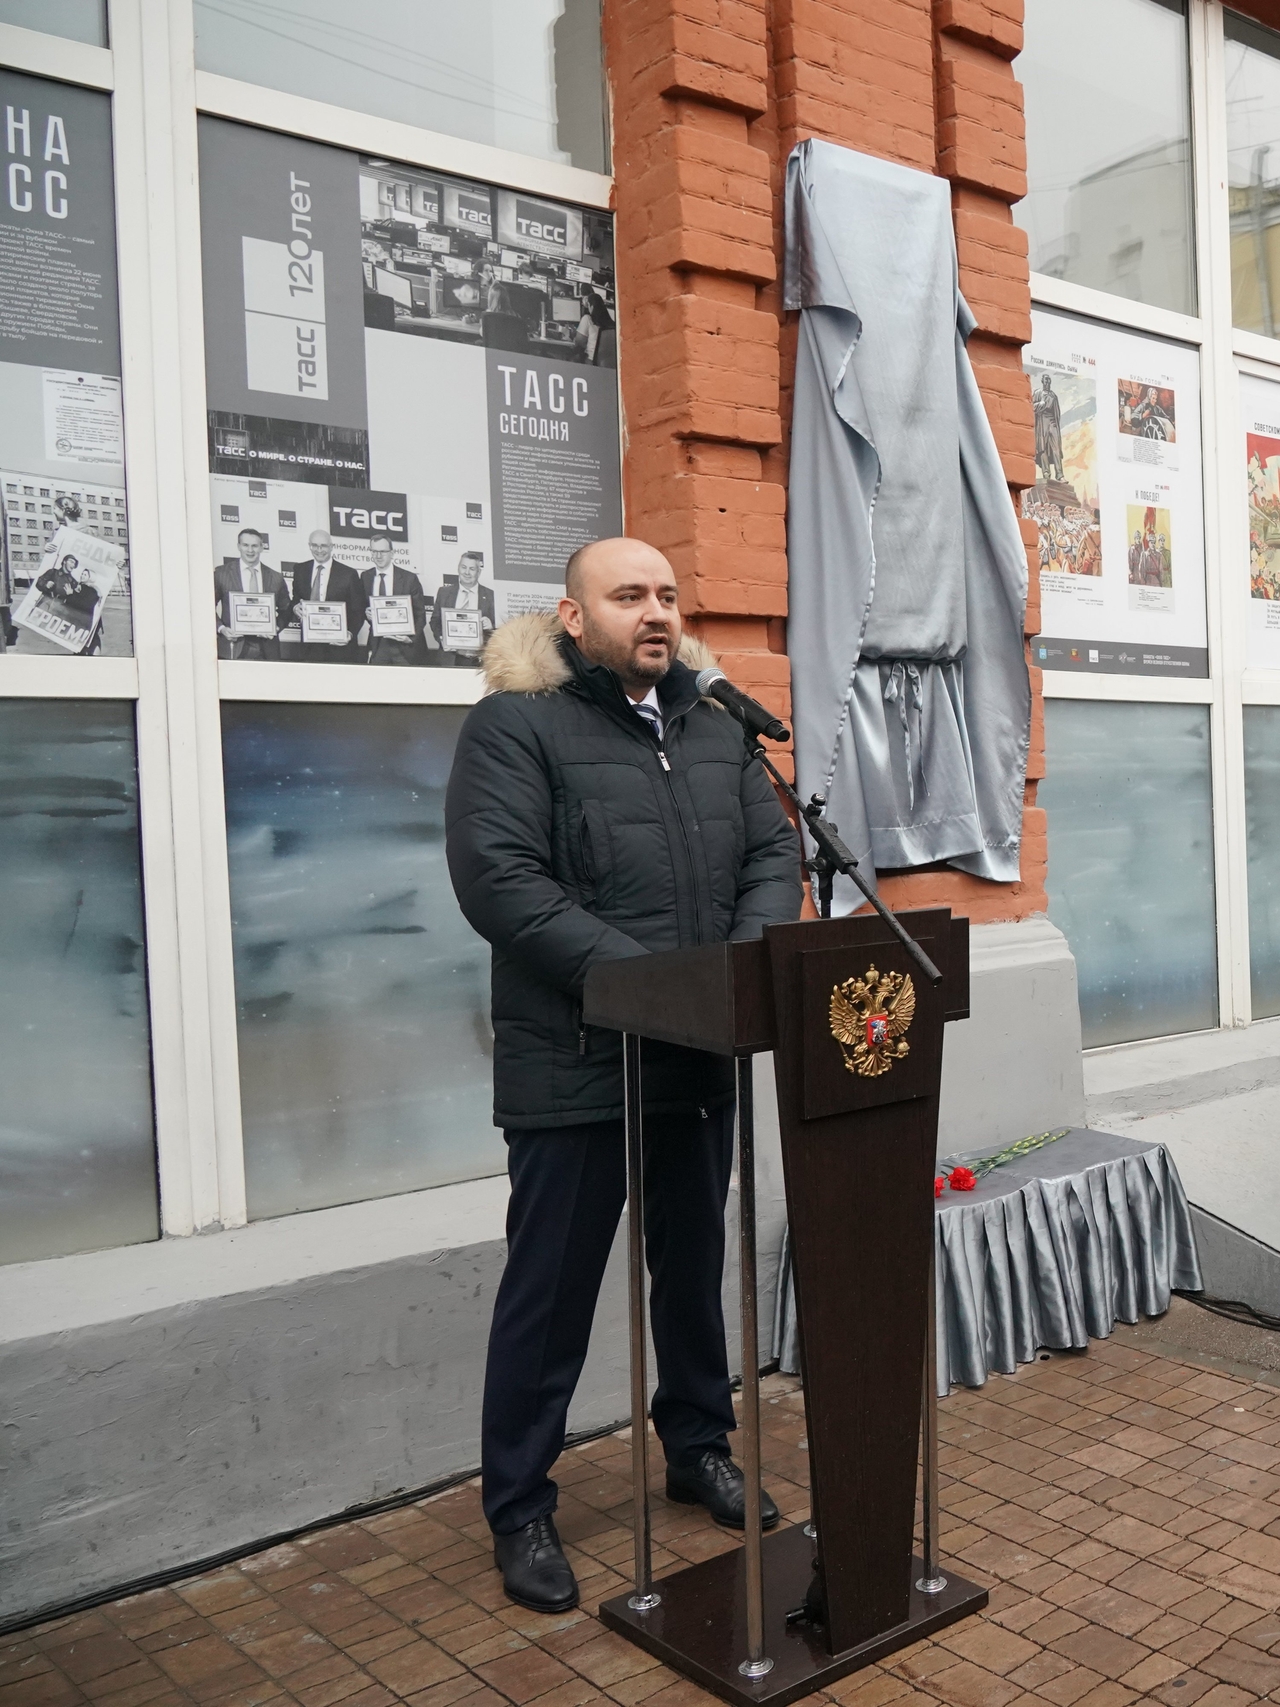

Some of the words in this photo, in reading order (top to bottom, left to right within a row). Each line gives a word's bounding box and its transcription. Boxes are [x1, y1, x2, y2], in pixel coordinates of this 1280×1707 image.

[25, 240, 43, 248] ТАСС
[498, 365, 589, 418] ТАСС
[500, 412, 569, 442] СЕГОДНЯ
[258, 451, 287, 462] МИРЕ.
[297, 456, 334, 467] СТРАНЕ.
[345, 461, 366, 470] НАС.
[70, 538, 117, 567] БУДЬ
[332, 543, 409, 555] ИНФОРМАНОЕ
